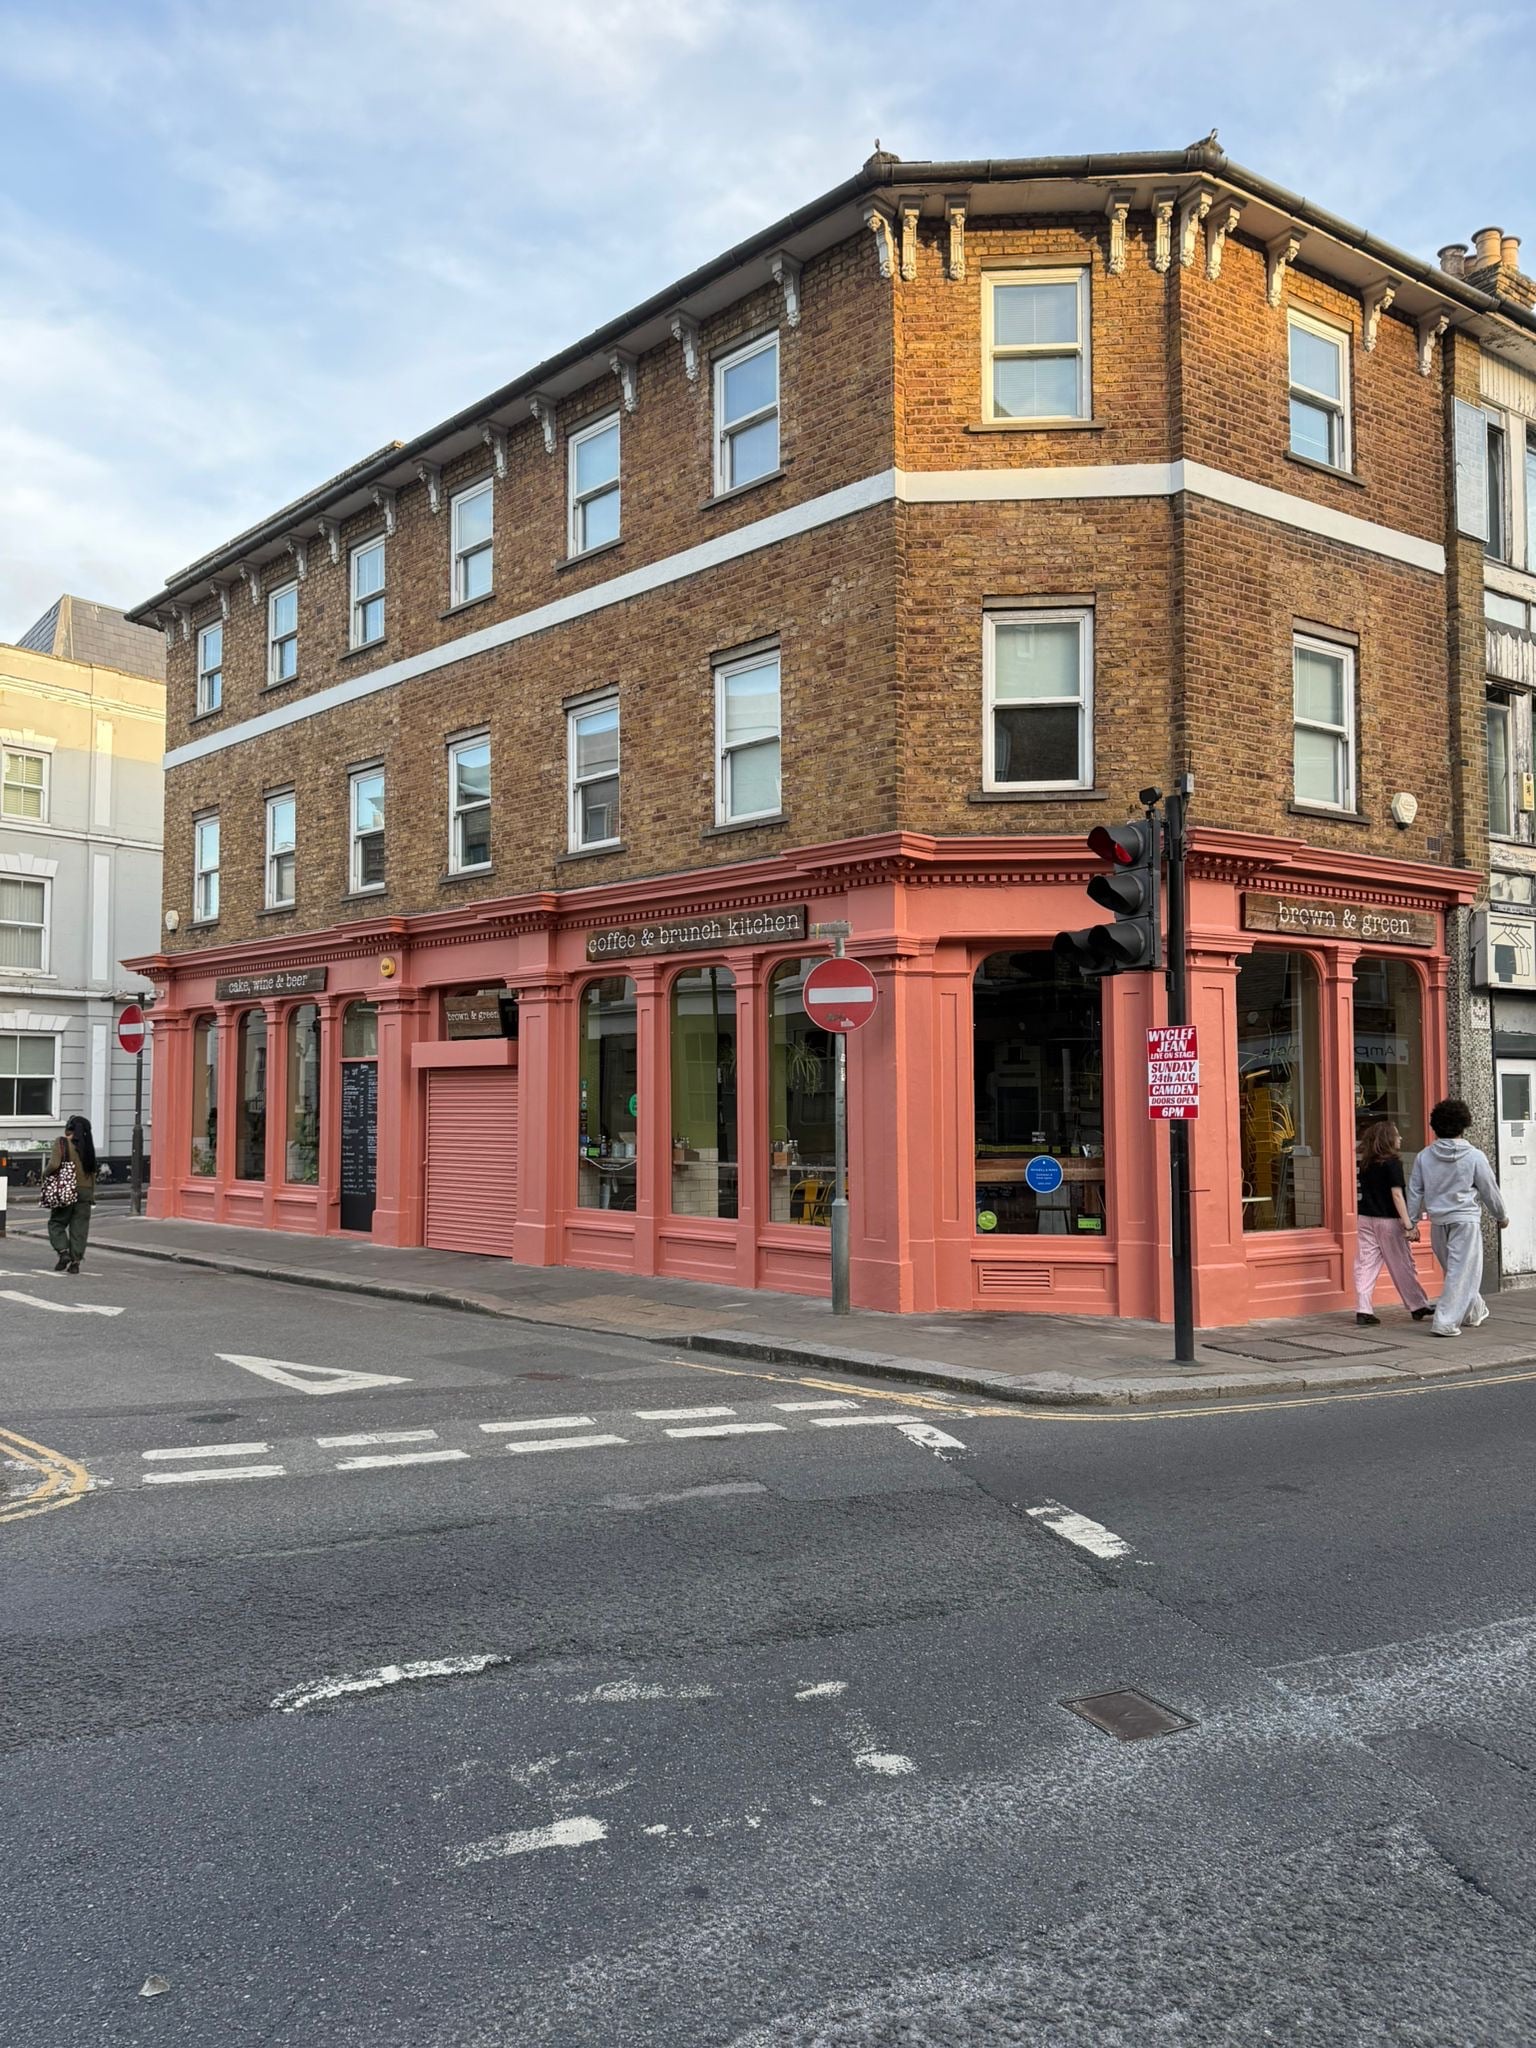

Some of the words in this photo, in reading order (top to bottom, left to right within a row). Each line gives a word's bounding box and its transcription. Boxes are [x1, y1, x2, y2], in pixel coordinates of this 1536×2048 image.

[1278, 902, 1336, 928] brown
[1343, 908, 1357, 930] &
[1361, 913, 1410, 936] green
[588, 931, 635, 953] coffee
[641, 928, 655, 947] &
[659, 921, 722, 945] brunch
[728, 914, 799, 937] kitchen
[228, 979, 250, 995] cake,
[252, 976, 274, 992] wine
[275, 974, 284, 989] &
[286, 973, 308, 988] beer
[446, 1011, 469, 1021] brown
[471, 1010, 477, 1020] &
[478, 1010, 500, 1021] green
[1148, 1028, 1194, 1042] WYCLEF
[1156, 1040, 1187, 1053] JEAN
[1150, 1052, 1163, 1060] LIVE
[1174, 1051, 1195, 1059] STAGE
[1151, 1061, 1195, 1073] SUNDAY
[1151, 1073, 1173, 1083] 24th
[1174, 1072, 1195, 1082] AUG
[1152, 1084, 1194, 1095] CAMDEN
[1176, 1096, 1195, 1104] OPEN
[1161, 1106, 1184, 1117] 6PM
